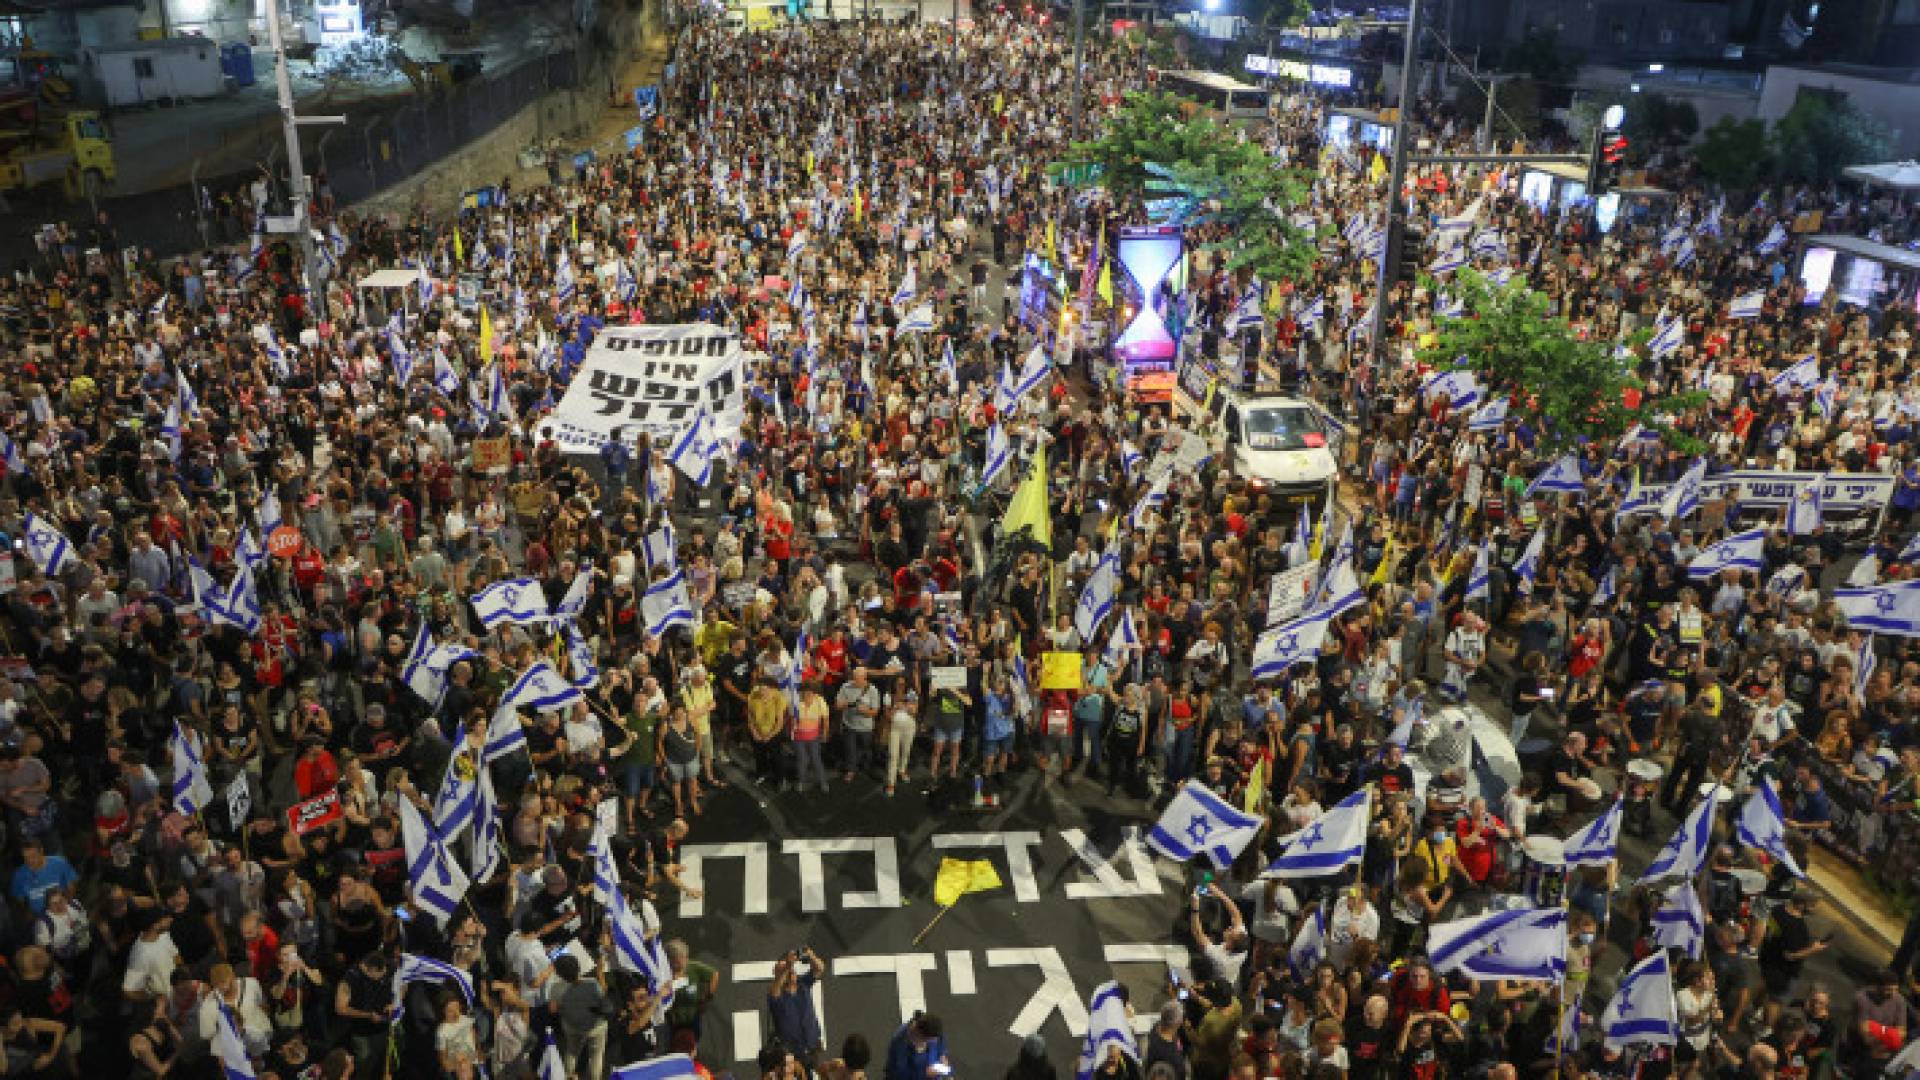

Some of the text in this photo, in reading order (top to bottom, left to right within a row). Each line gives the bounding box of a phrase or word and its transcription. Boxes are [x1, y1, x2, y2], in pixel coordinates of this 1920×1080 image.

[606, 336, 727, 355] חטופים
[645, 361, 698, 380] אין
[588, 368, 734, 400] חופש
